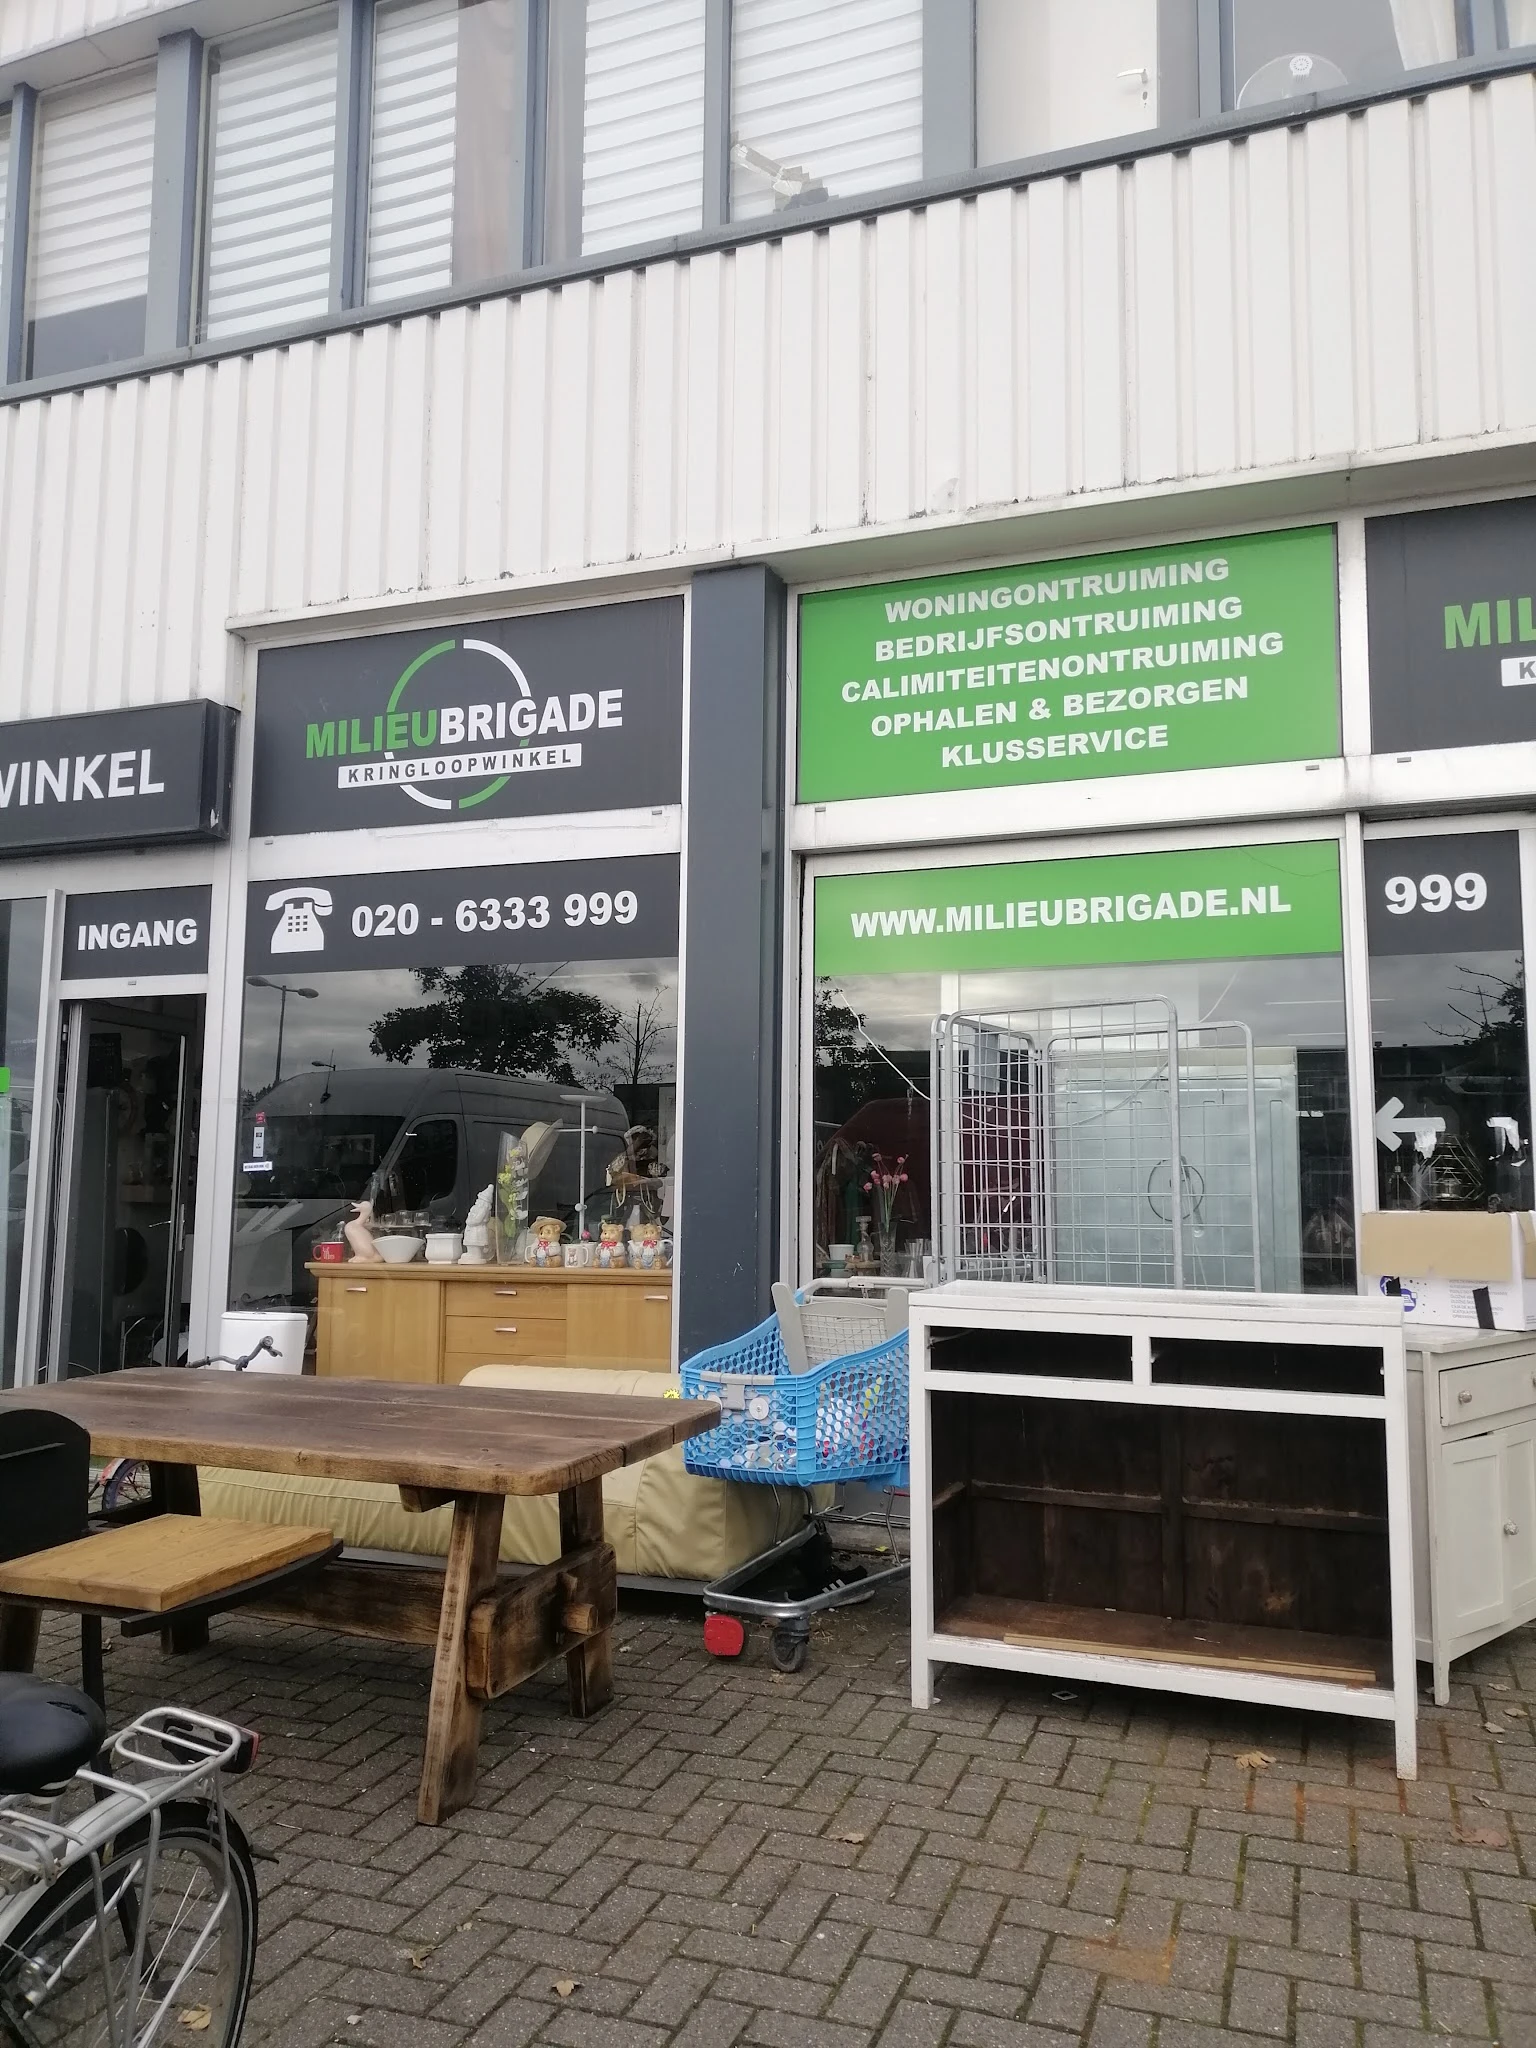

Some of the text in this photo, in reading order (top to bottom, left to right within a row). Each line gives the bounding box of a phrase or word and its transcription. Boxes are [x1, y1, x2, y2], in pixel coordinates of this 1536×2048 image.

[884, 558, 1230, 623] WONINGONTRUIMING
[874, 596, 1243, 662] BEDRIJFSONTRUIMING
[841, 632, 1284, 702] CALIMITEITENONTRUIMING
[305, 688, 623, 759] MILIEUBRIGADE
[871, 676, 1249, 737] OPHALEN & BEZORGEN
[347, 748, 573, 783] KRINGLOOPWINKEL
[941, 724, 1169, 768] KLUSSERVICE
[351, 902, 420, 938] 020
[455, 895, 551, 933] 6333
[563, 890, 638, 927] 999
[850, 885, 1292, 938] WWW.MILIEUBRIGADE.NL
[1384, 872, 1488, 915] 999
[77, 918, 198, 951] INGANG
